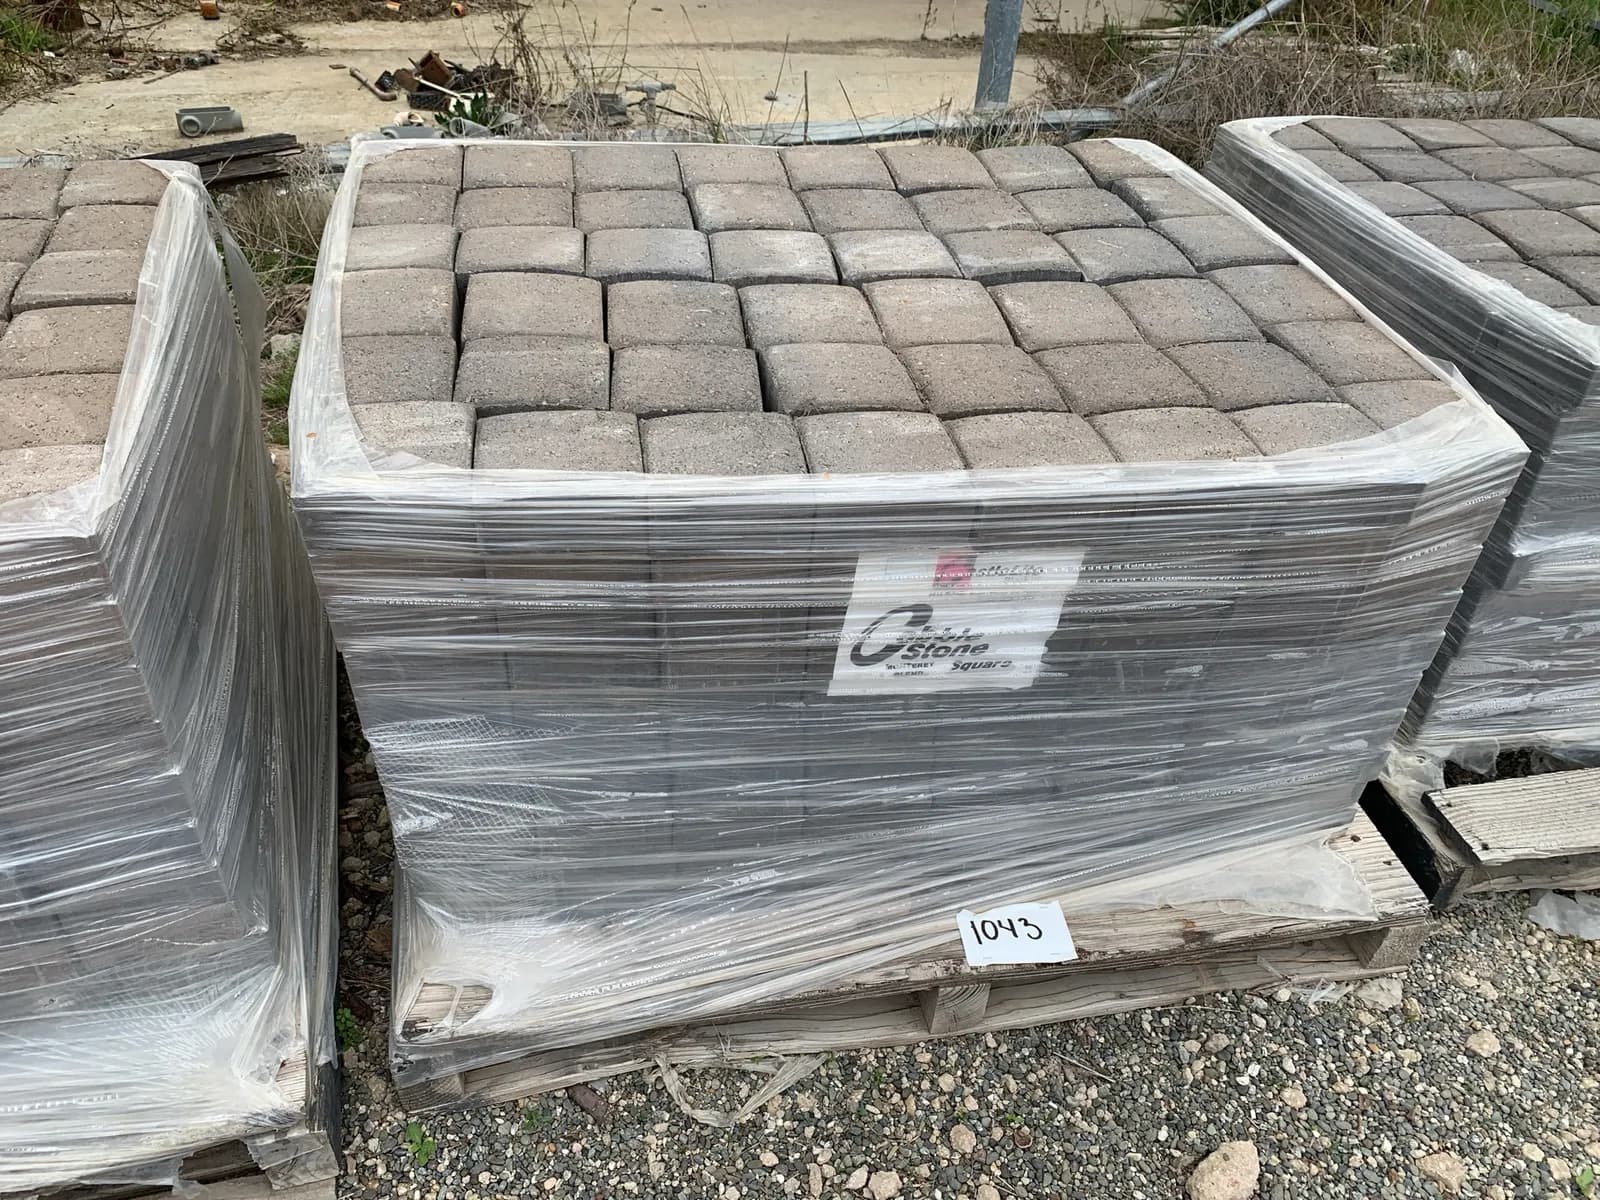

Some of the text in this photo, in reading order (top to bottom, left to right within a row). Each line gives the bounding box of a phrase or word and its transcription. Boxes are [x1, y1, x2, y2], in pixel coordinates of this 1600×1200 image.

[900, 641, 990, 660] Stone
[951, 660, 1012, 672] Square
[970, 917, 1043, 945] 1043
